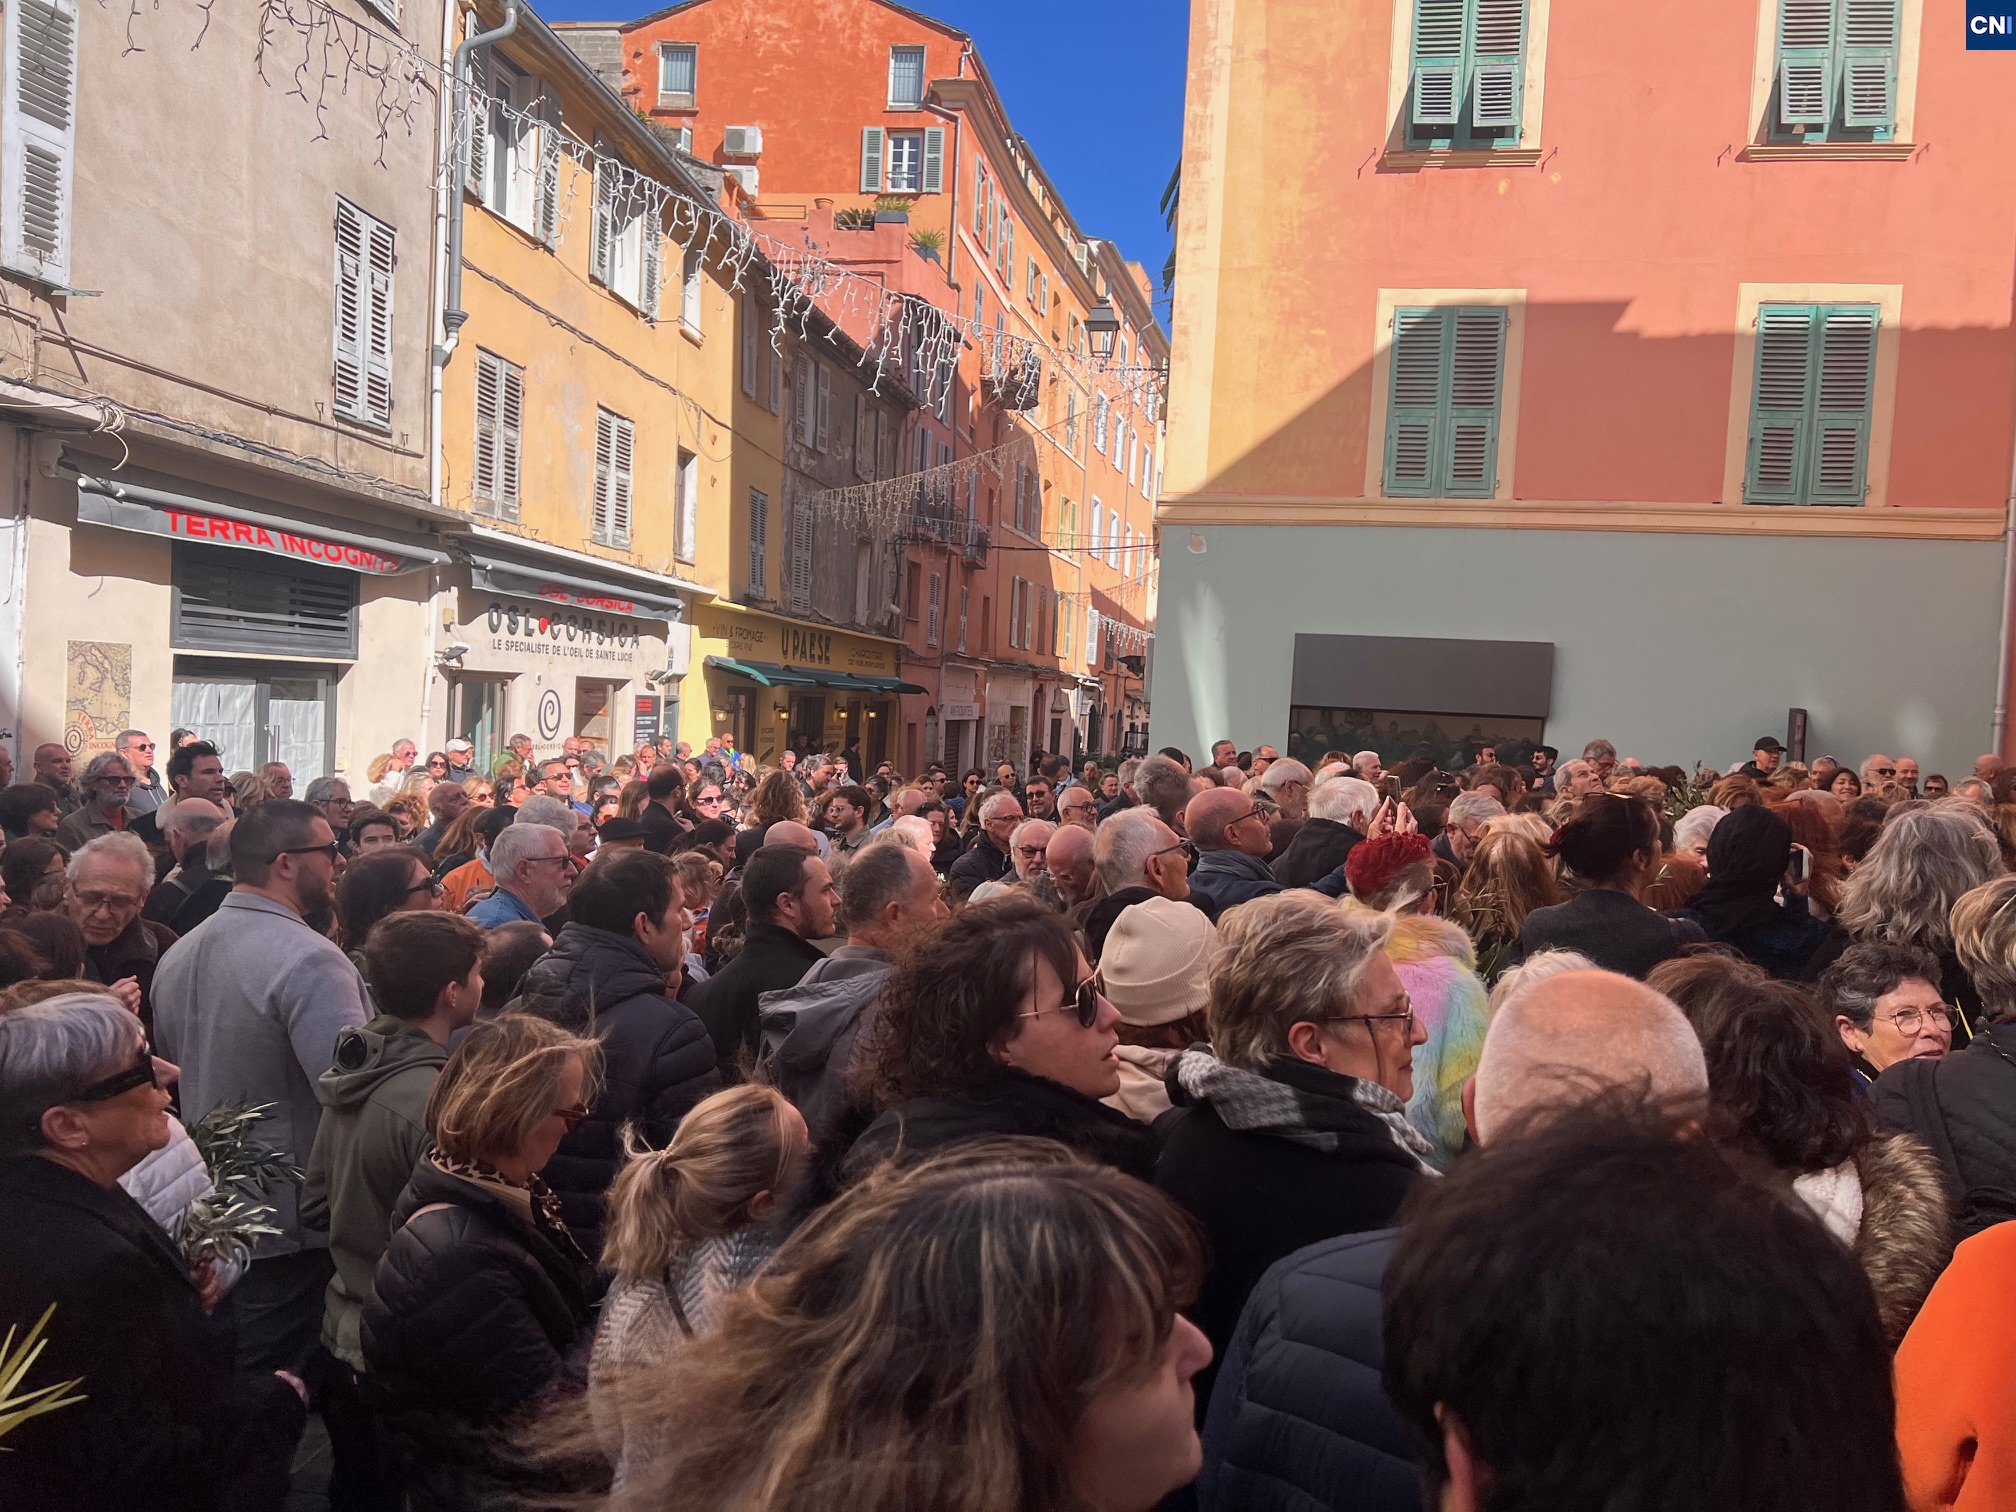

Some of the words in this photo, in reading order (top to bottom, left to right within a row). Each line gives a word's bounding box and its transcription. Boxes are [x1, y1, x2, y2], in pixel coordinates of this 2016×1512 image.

[164, 511, 275, 549] TERRA
[537, 583, 568, 601] OSL
[576, 590, 633, 613] CORSICA
[488, 602, 535, 637] OSL
[549, 611, 640, 650] CORSICA
[492, 638, 502, 650] LE
[505, 640, 550, 653] SPECIALISTE
[552, 645, 561, 655] DE
[585, 649, 594, 659] DE
[595, 650, 616, 661] SAINTE
[617, 652, 633, 662] LUCIE
[781, 628, 789, 659] U
[793, 629, 831, 665] PAESE
[77, 712, 95, 740] TERRA
[89, 741, 116, 750] INCOGN
